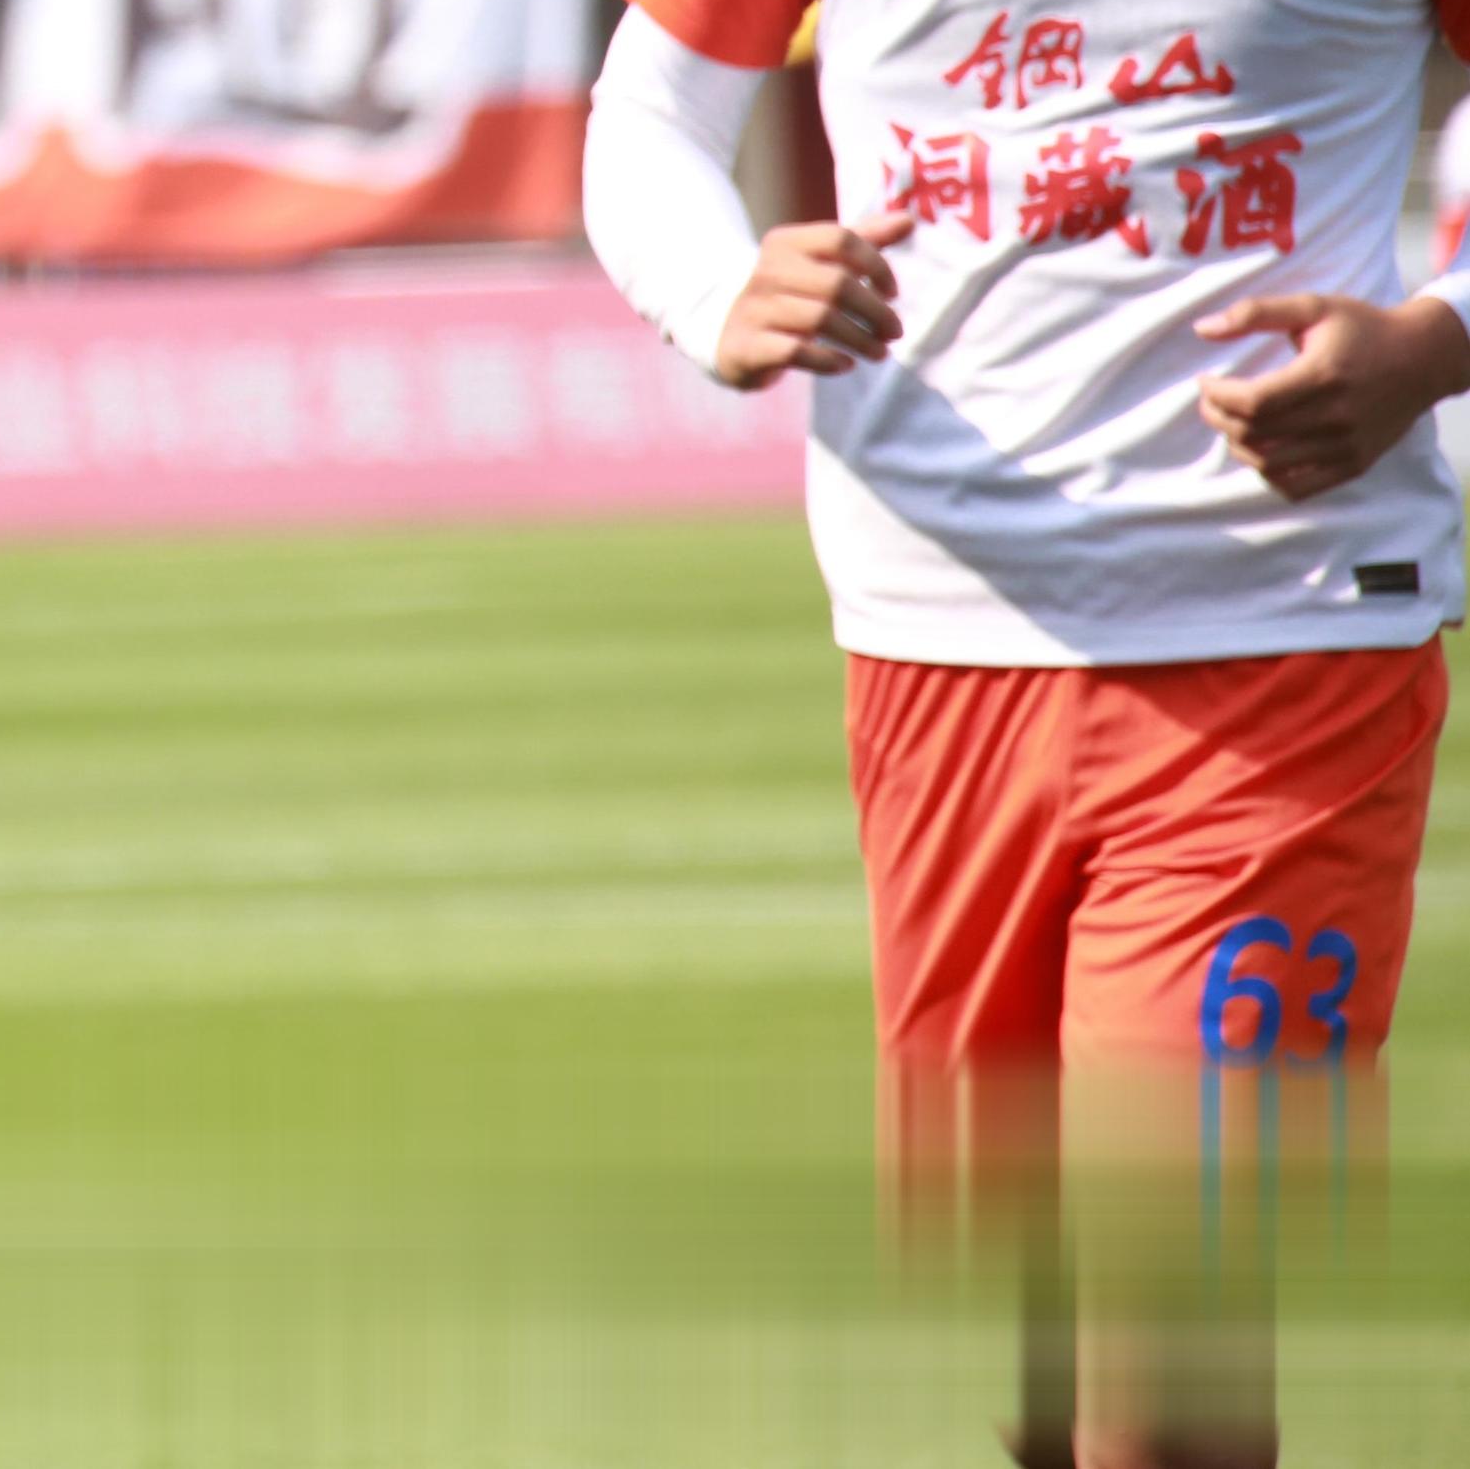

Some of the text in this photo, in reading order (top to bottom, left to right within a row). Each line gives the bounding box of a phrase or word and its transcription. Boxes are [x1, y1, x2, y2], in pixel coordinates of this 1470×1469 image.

[883, 124, 1304, 259] 洞藏酒
[1201, 914, 1357, 1075] 63
